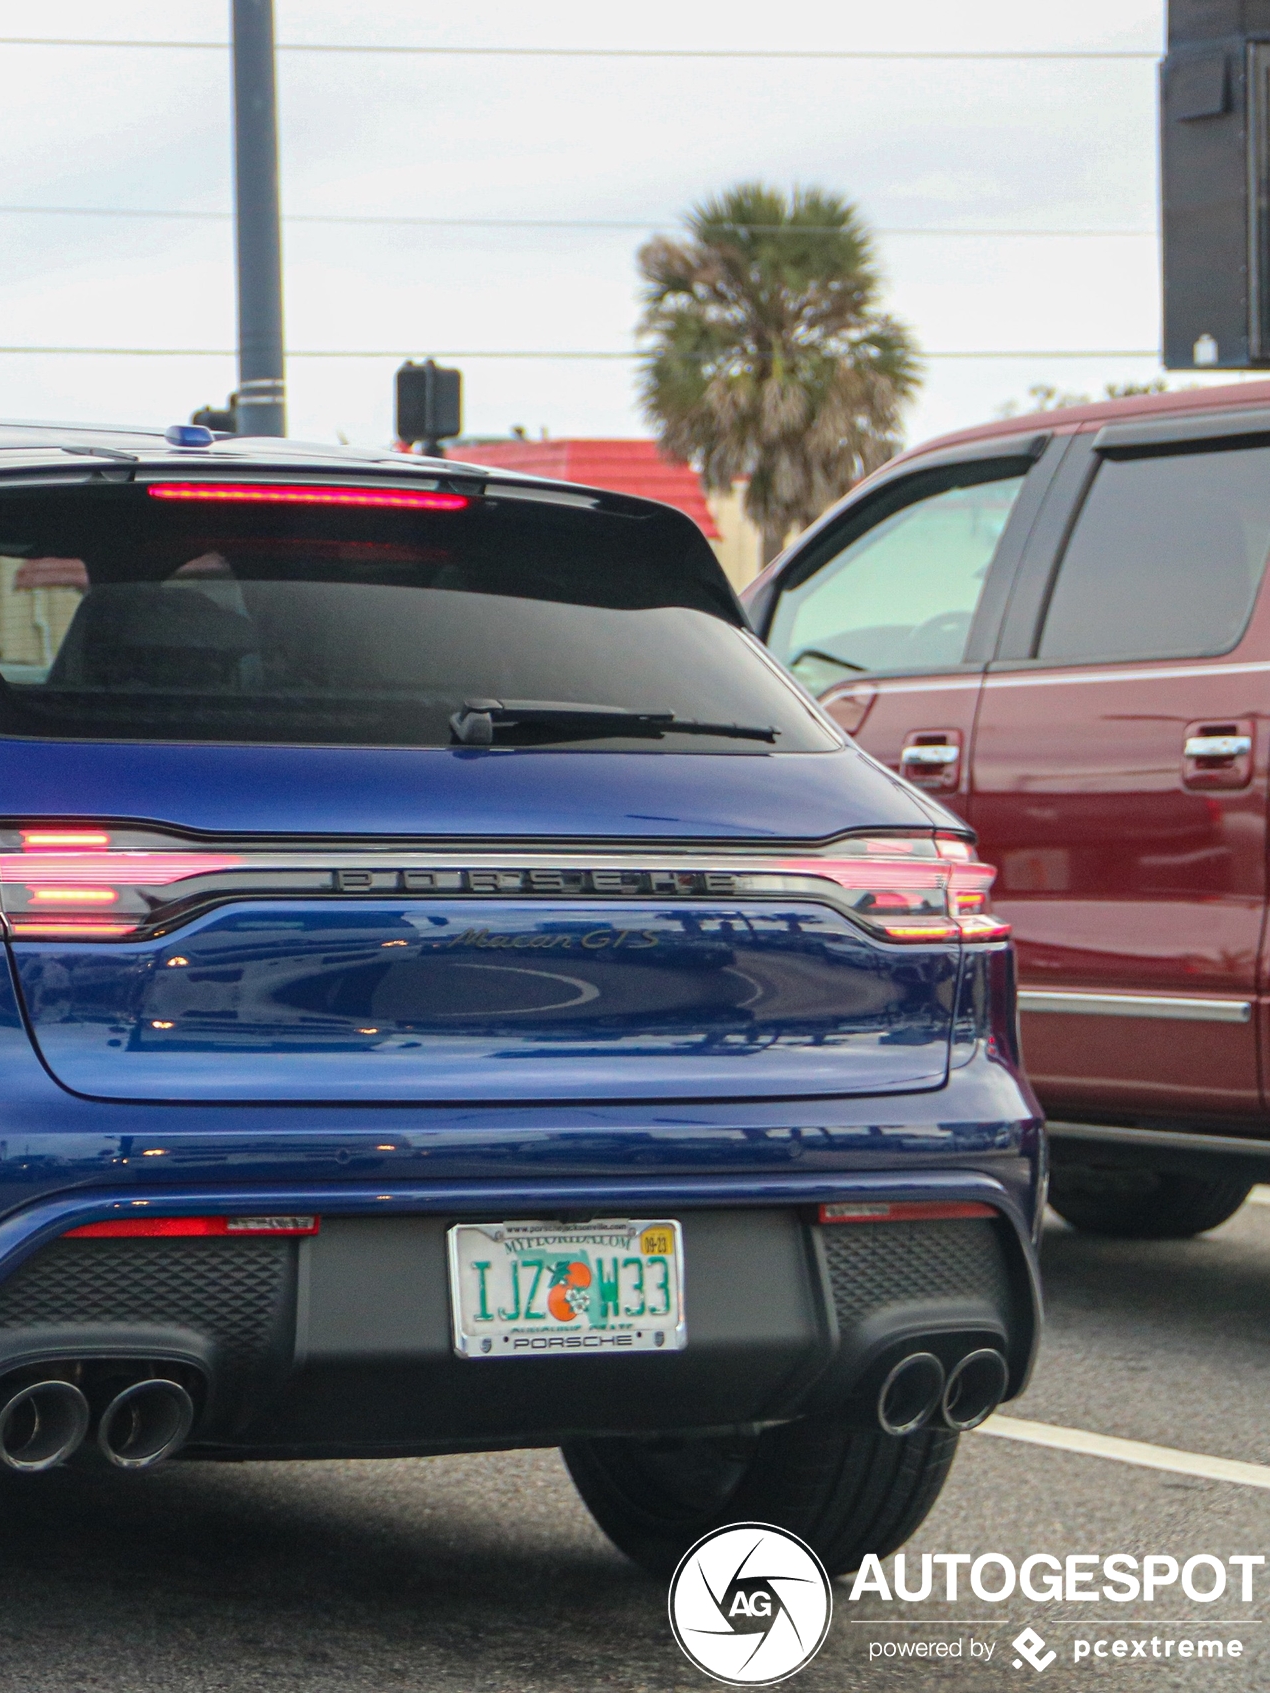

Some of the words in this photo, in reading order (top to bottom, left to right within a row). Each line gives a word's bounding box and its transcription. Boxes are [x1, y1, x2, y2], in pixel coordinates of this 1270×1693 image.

[336, 870, 736, 893] PORSCHE
[447, 928, 571, 948] Macan
[581, 929, 660, 949] GTS
[596, 1256, 671, 1318] W33
[513, 1335, 633, 1349] PORSCHE
